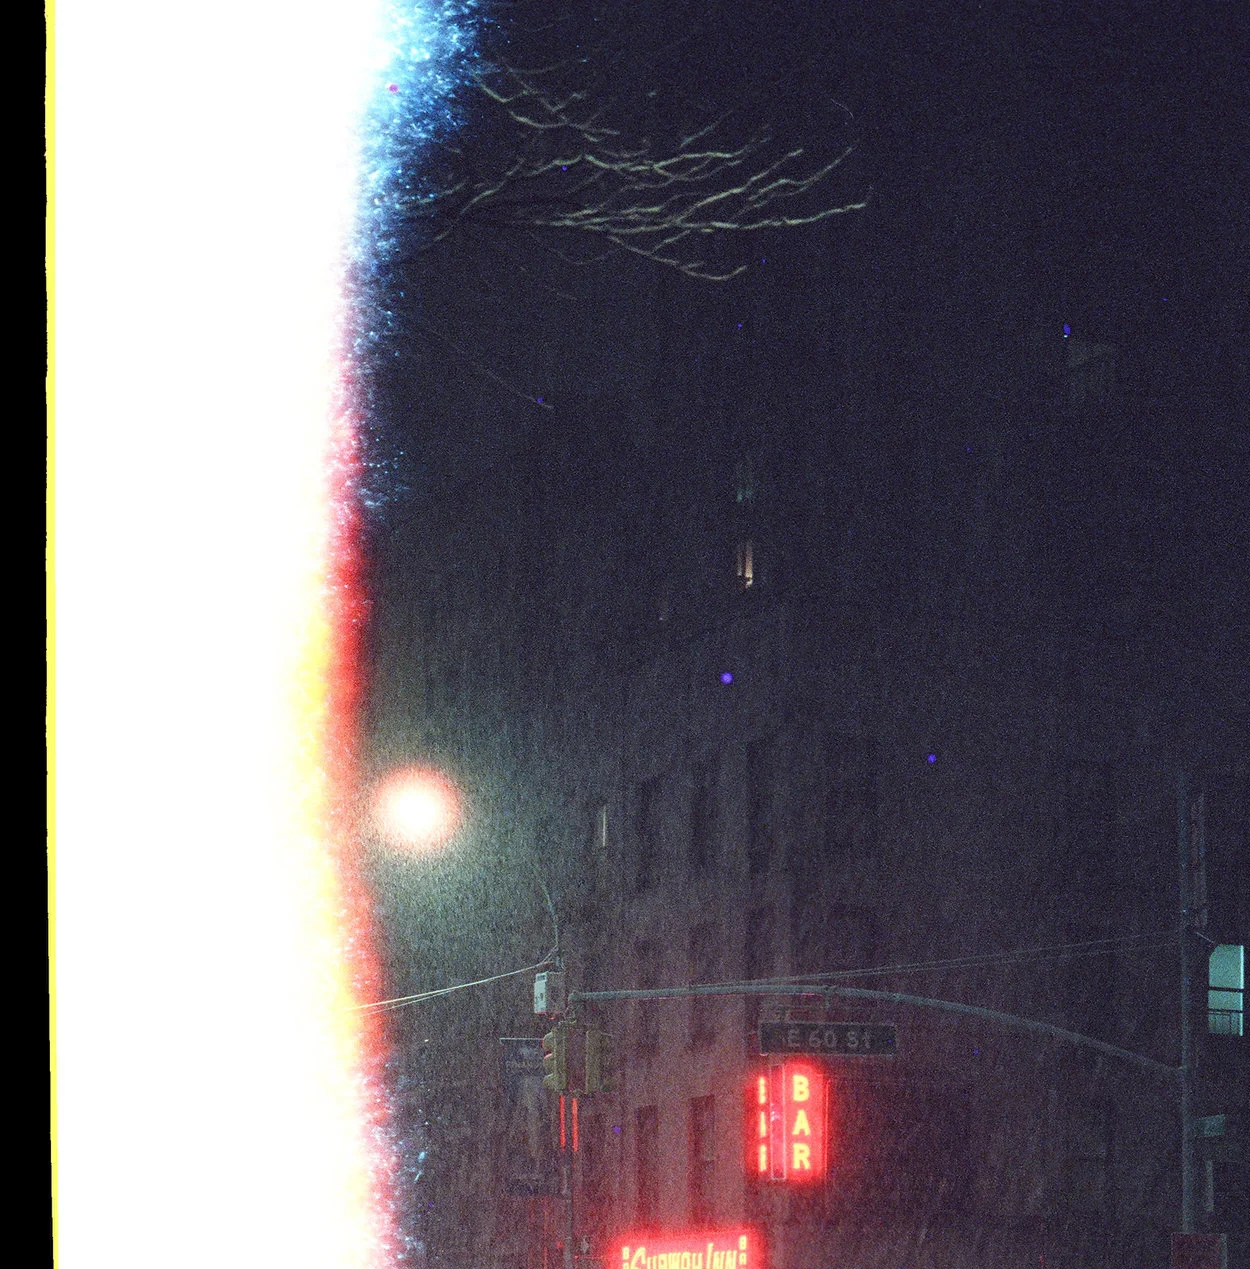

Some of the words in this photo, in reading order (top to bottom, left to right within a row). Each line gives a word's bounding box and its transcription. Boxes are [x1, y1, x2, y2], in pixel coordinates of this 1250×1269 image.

[787, 1028, 800, 1047] E
[808, 1029, 838, 1048] 60
[846, 1029, 871, 1049] St
[792, 1074, 811, 1171] BAR
